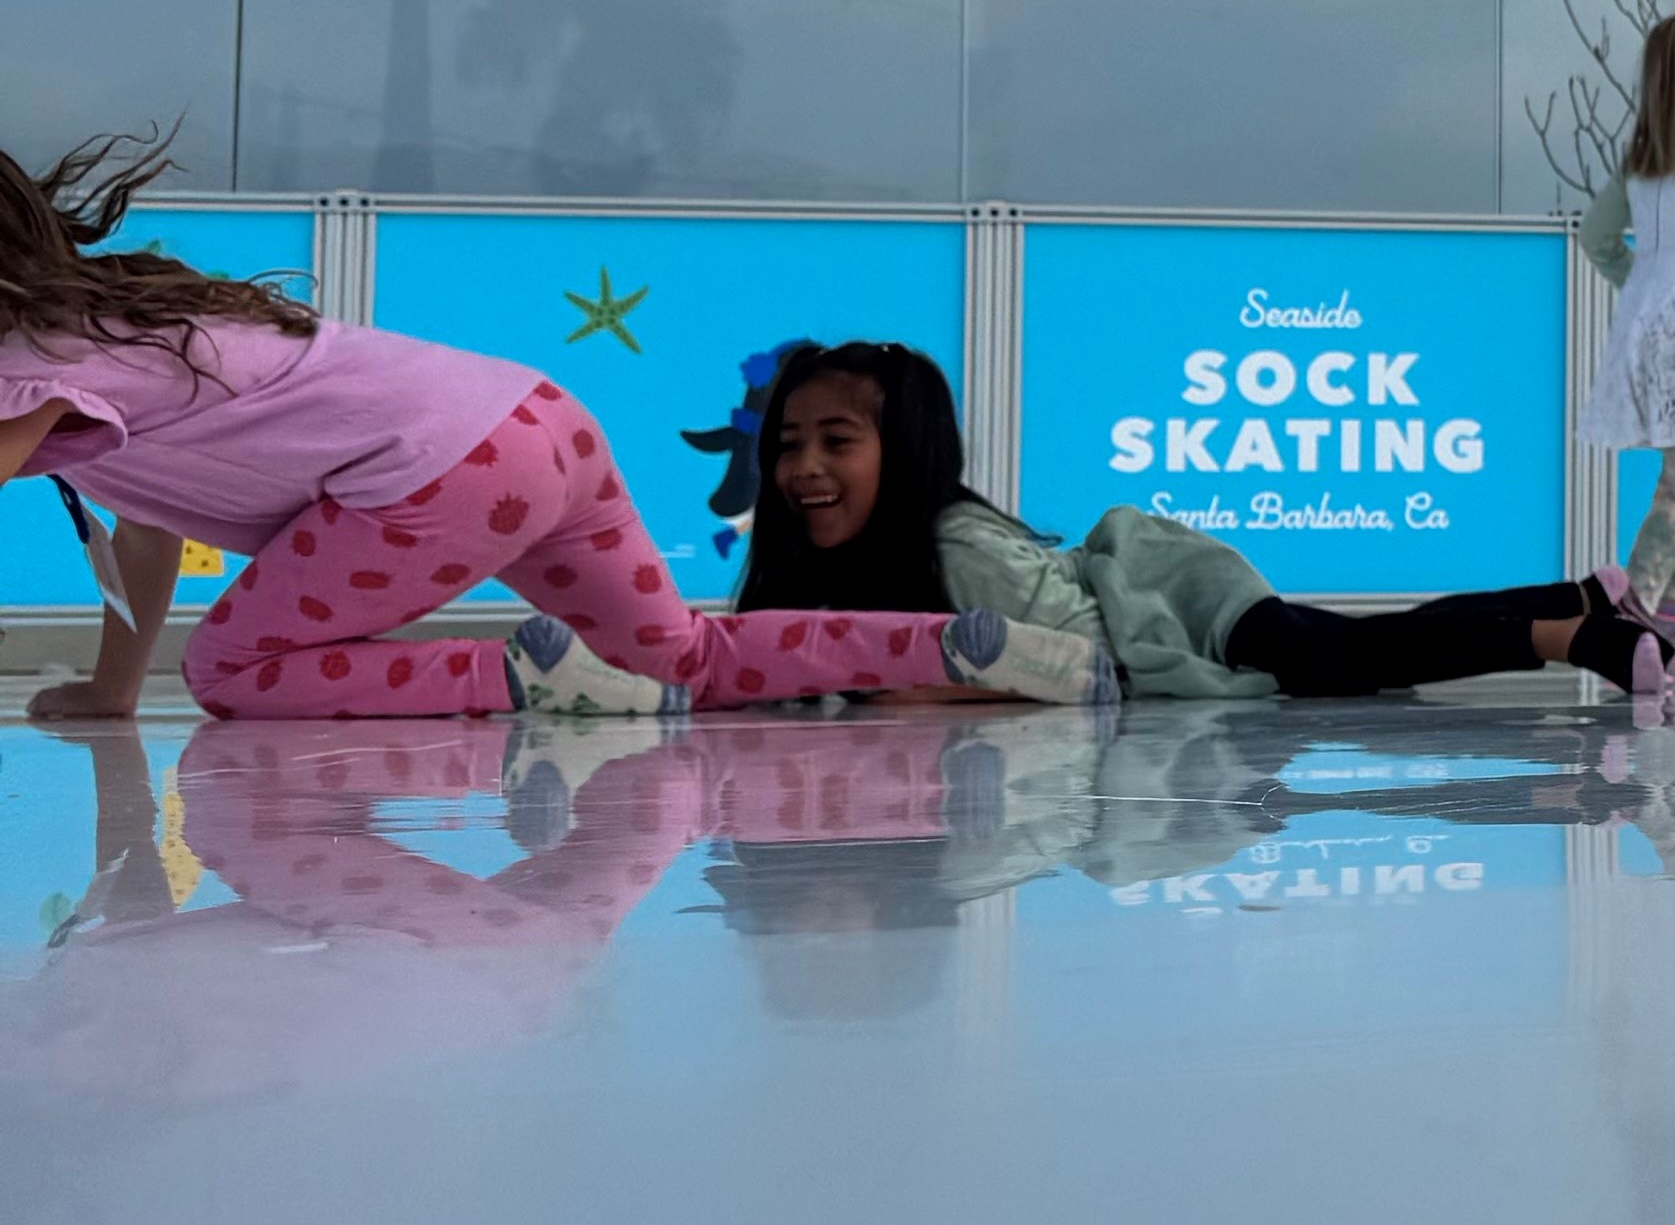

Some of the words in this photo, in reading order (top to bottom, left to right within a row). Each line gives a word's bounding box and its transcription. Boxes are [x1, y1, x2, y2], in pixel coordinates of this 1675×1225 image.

[1239, 288, 1363, 329] Seaside
[1181, 349, 1421, 407] SOCK
[1108, 417, 1485, 474] SKATING
[1147, 491, 1239, 531] Santa
[1245, 491, 1394, 531] Barbara,
[1405, 491, 1450, 530] Ca
